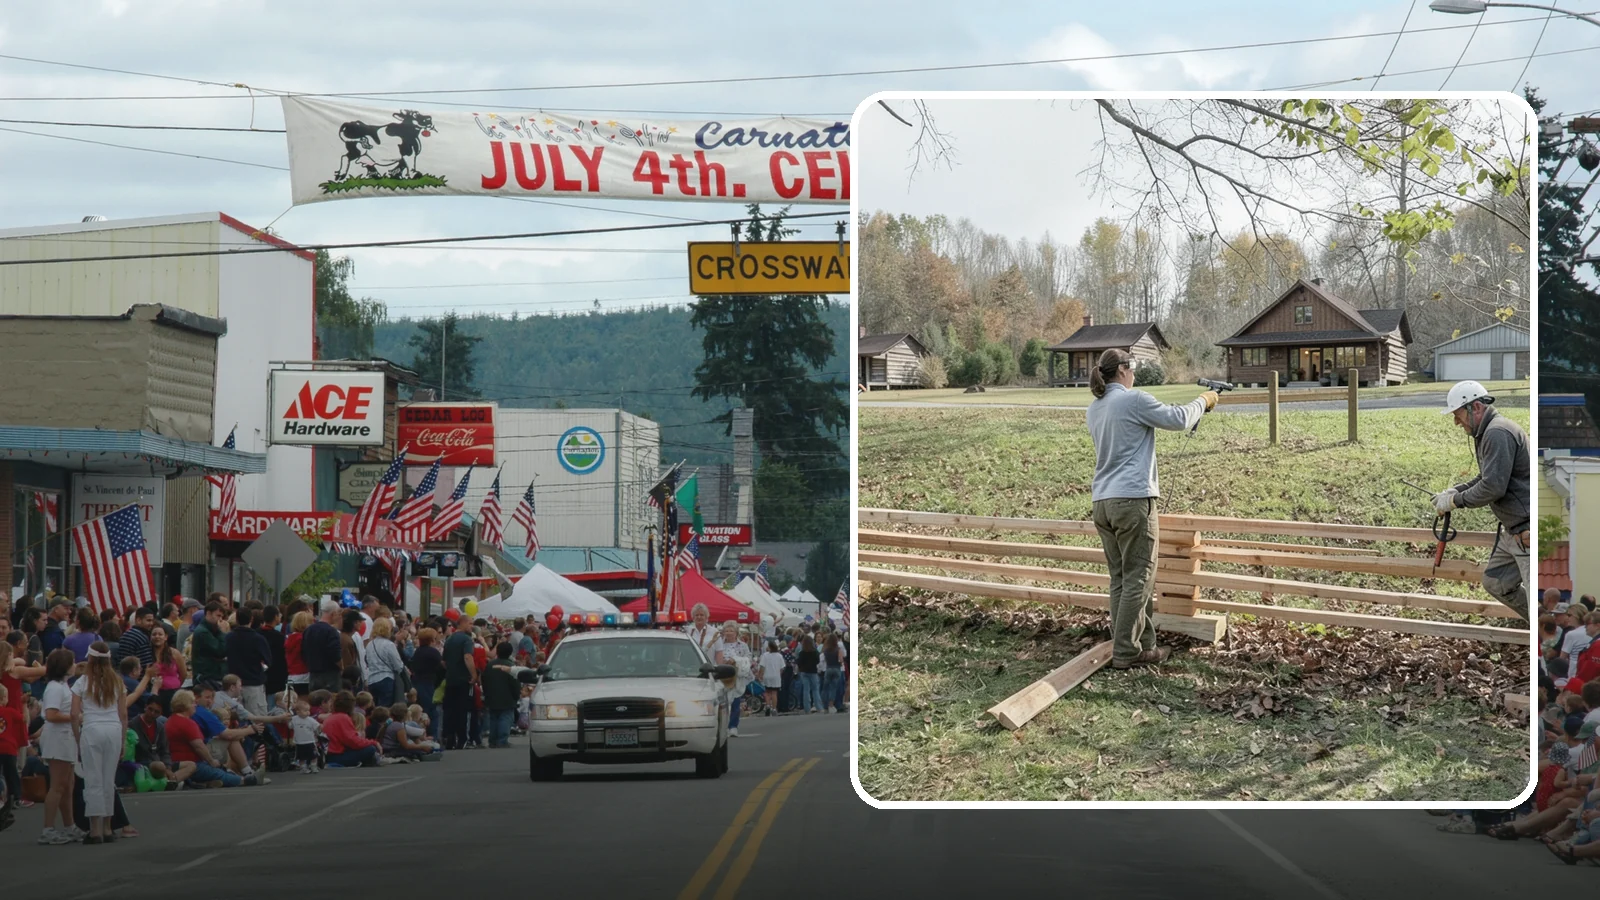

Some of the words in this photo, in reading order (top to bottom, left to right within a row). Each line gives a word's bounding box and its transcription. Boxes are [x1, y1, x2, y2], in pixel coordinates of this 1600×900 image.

[481, 141, 604, 193] JULY
[632, 150, 746, 198] 4th.
[697, 254, 850, 280] CROSSWA
[283, 380, 373, 420] ACE
[405, 409, 452, 422] CEDAR
[283, 421, 371, 436] Hardware
[416, 428, 477, 447] Coca-Cola
[83, 485, 94, 494] St.
[96, 485, 124, 495] Vincent
[126, 486, 136, 495] de
[138, 486, 155, 495] Paul
[688, 526, 741, 535] CRNATION
[699, 535, 730, 543] GLASS
